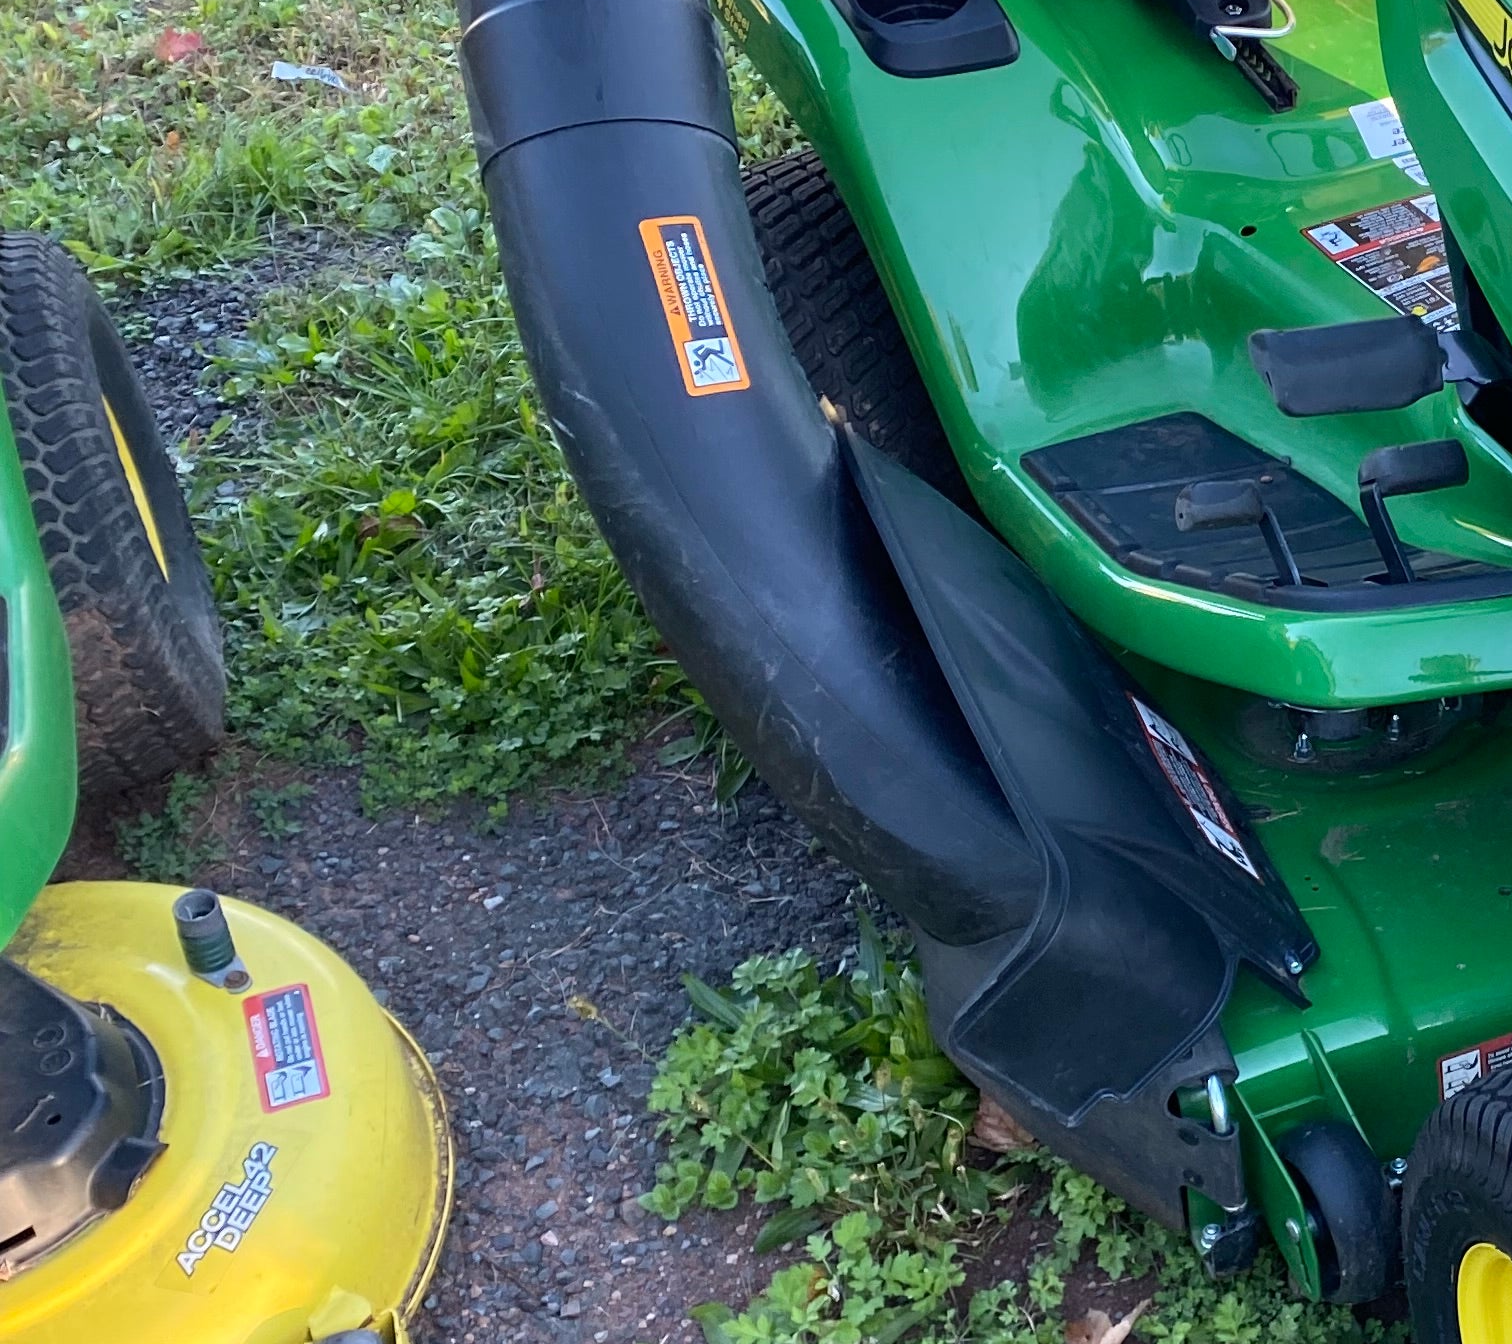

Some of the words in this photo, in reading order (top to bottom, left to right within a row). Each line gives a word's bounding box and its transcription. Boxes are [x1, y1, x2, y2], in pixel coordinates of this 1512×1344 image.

[724, 7, 747, 42] Steer
[653, 249, 677, 306] WARNING
[666, 240, 685, 282] OBJECTS
[679, 282, 698, 323] THROWN
[250, 1013, 266, 1051] DANGER
[213, 1170, 273, 1253] DEEP
